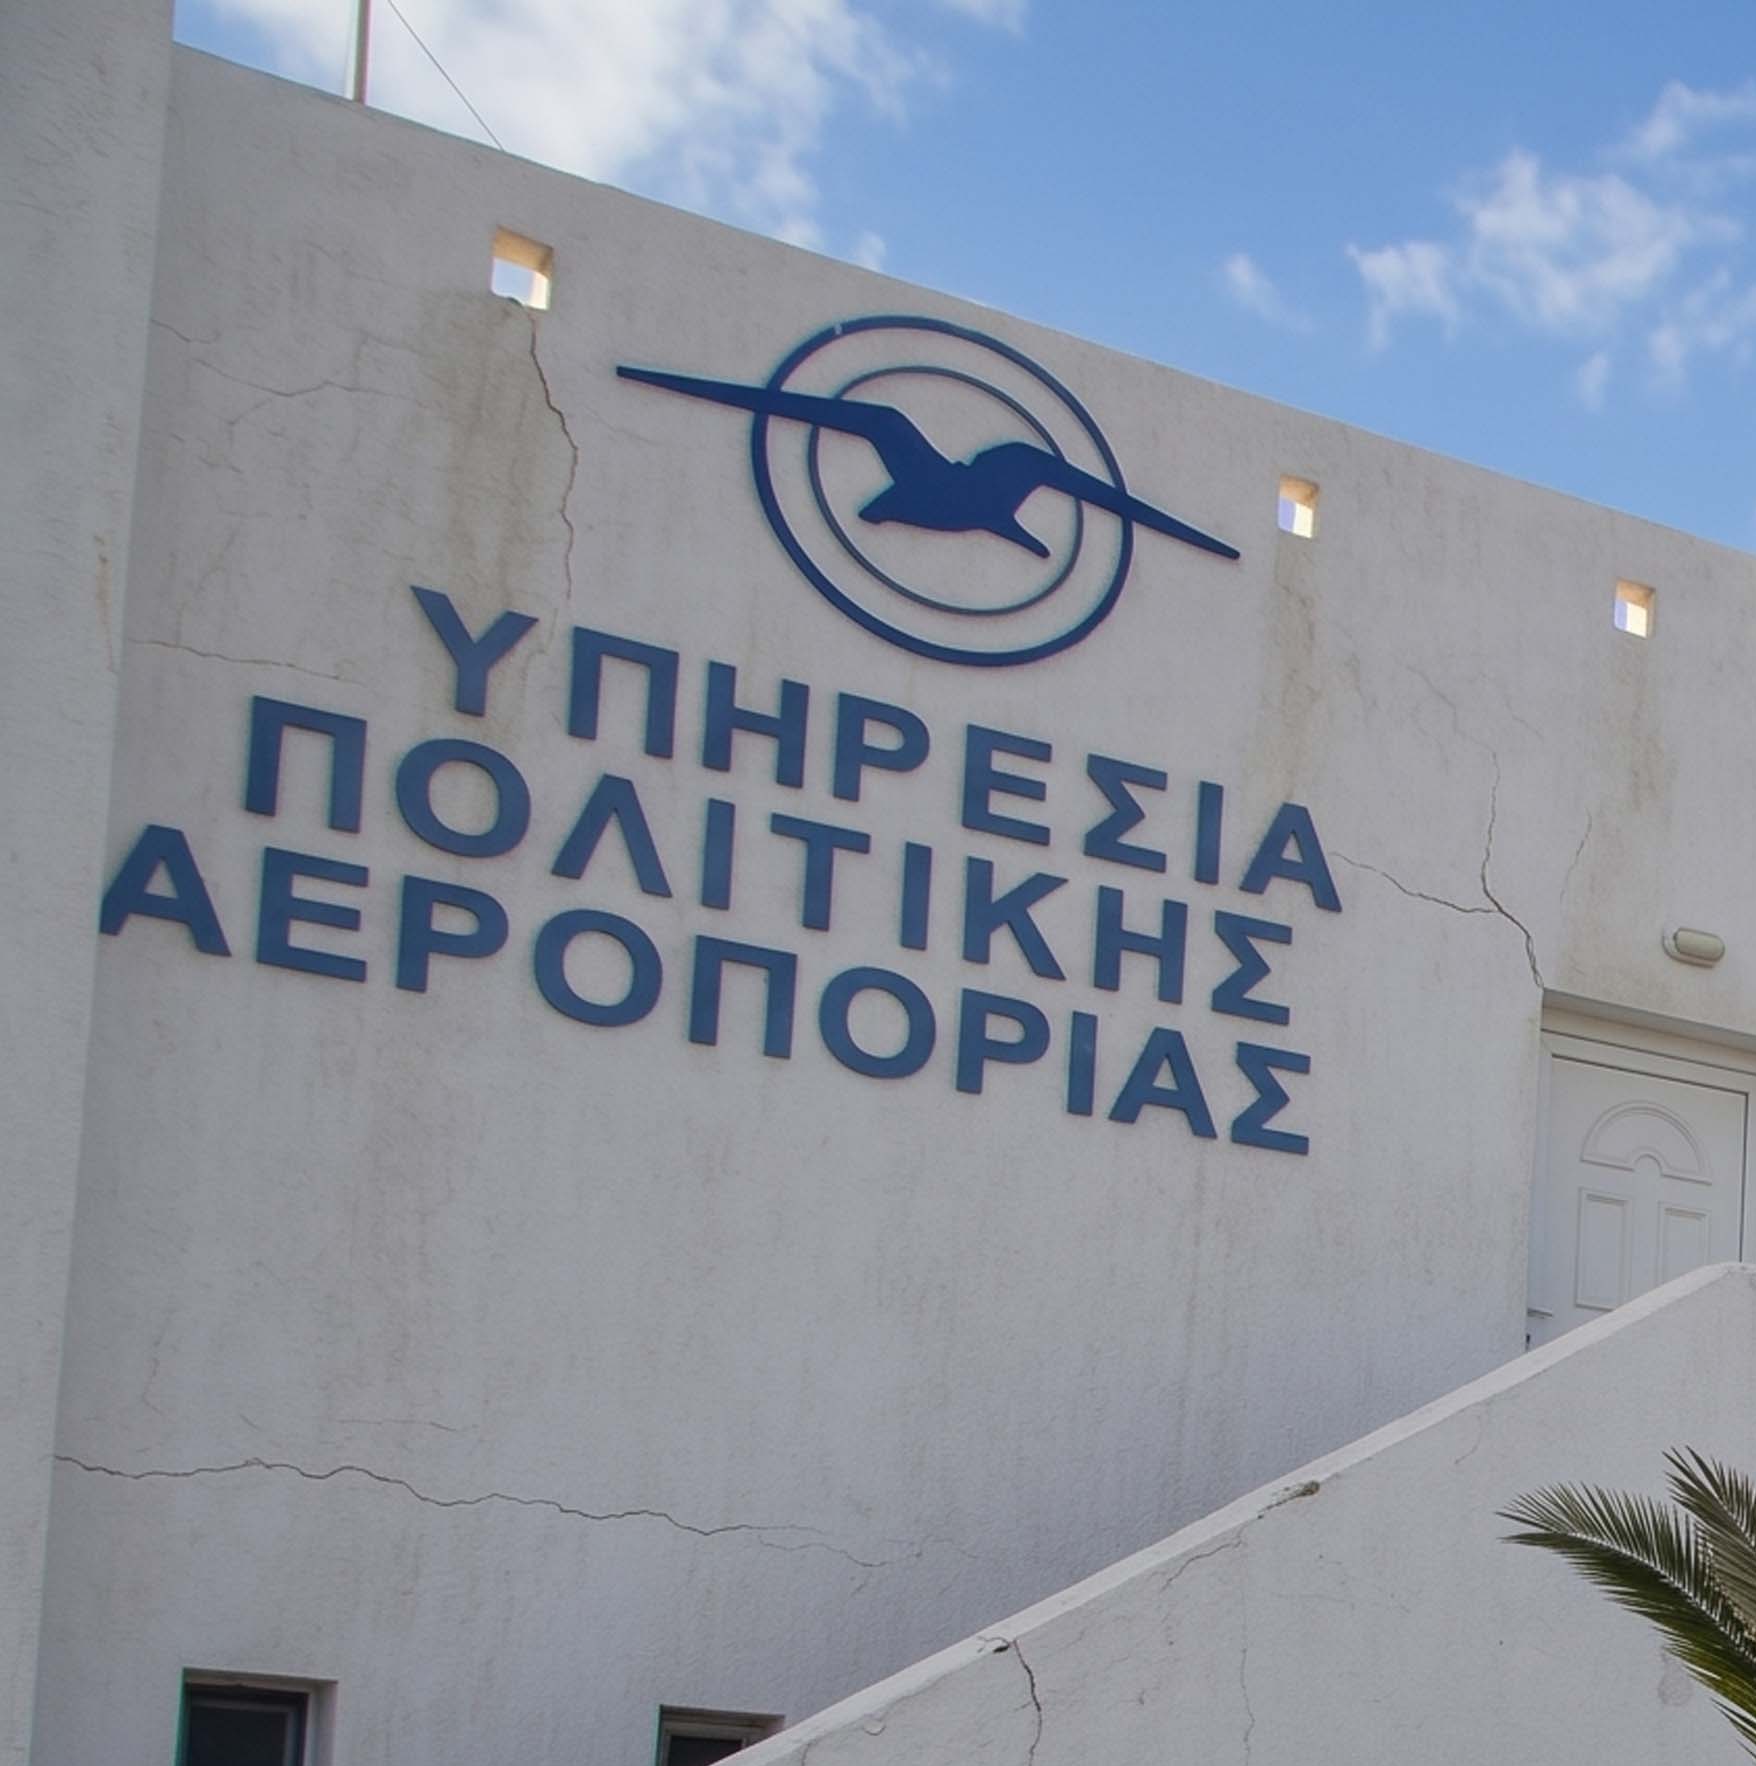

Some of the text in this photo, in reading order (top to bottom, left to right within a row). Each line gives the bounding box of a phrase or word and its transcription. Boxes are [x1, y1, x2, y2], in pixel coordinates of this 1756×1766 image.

[243, 694, 1294, 1025] ΠΟΛΙΤΙΚΗΣ
[411, 585, 1343, 911] ΥΠΗΡΕΣΙΑ
[98, 822, 1312, 1154] ΑΕΡΟΠΟΡΙΑΣ
